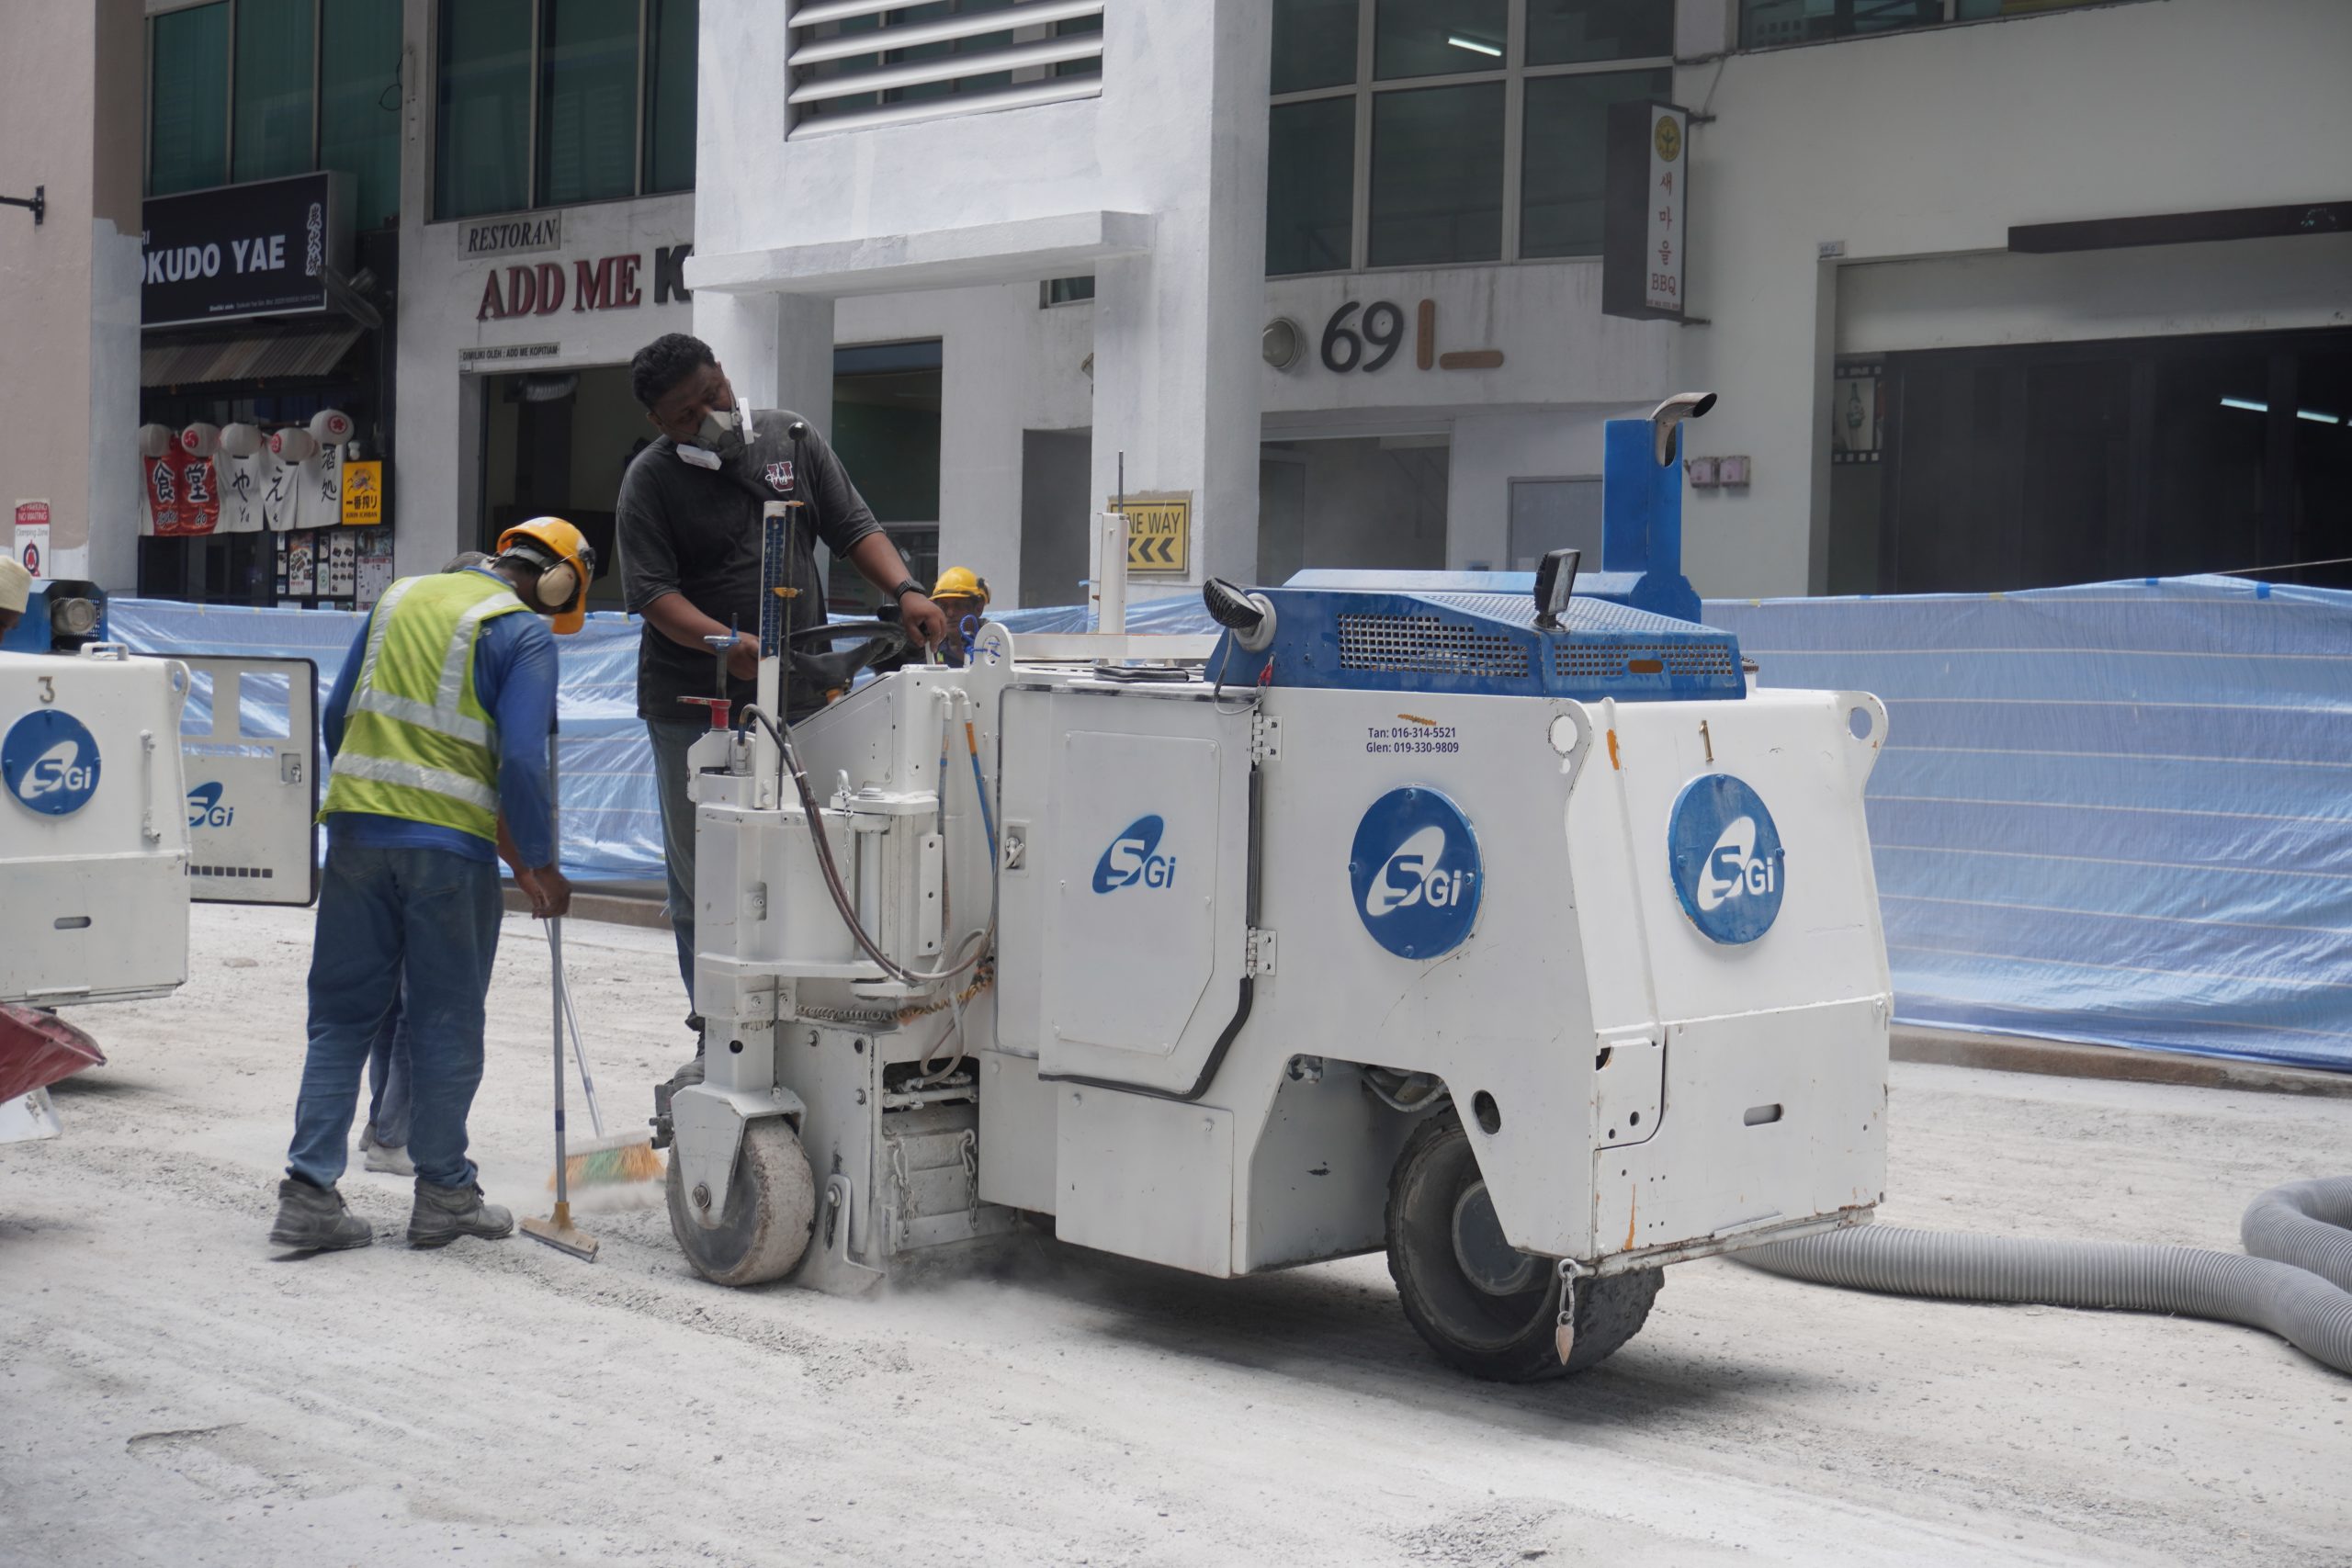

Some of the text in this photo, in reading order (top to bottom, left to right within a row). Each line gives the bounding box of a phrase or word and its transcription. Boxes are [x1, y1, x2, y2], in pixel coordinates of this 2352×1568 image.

[1658, 172, 1672, 265] 새마을
[468, 219, 557, 252] RESTORAN
[232, 234, 286, 274] YAE
[476, 262, 566, 321] ADD
[572, 254, 641, 312] ME
[1651, 274, 1676, 295] BBQ
[1320, 299, 1404, 374] 69
[486, 348, 502, 359] OLEH
[505, 347, 517, 358] ADD
[529, 344, 558, 356] KOPITIAM
[1126, 512, 1181, 535] NE WAY
[38, 676, 55, 703] 3
[1367, 727, 1456, 739] Tan: 016-314-5521
[1366, 742, 1459, 753] Glen: 019-330-9809
